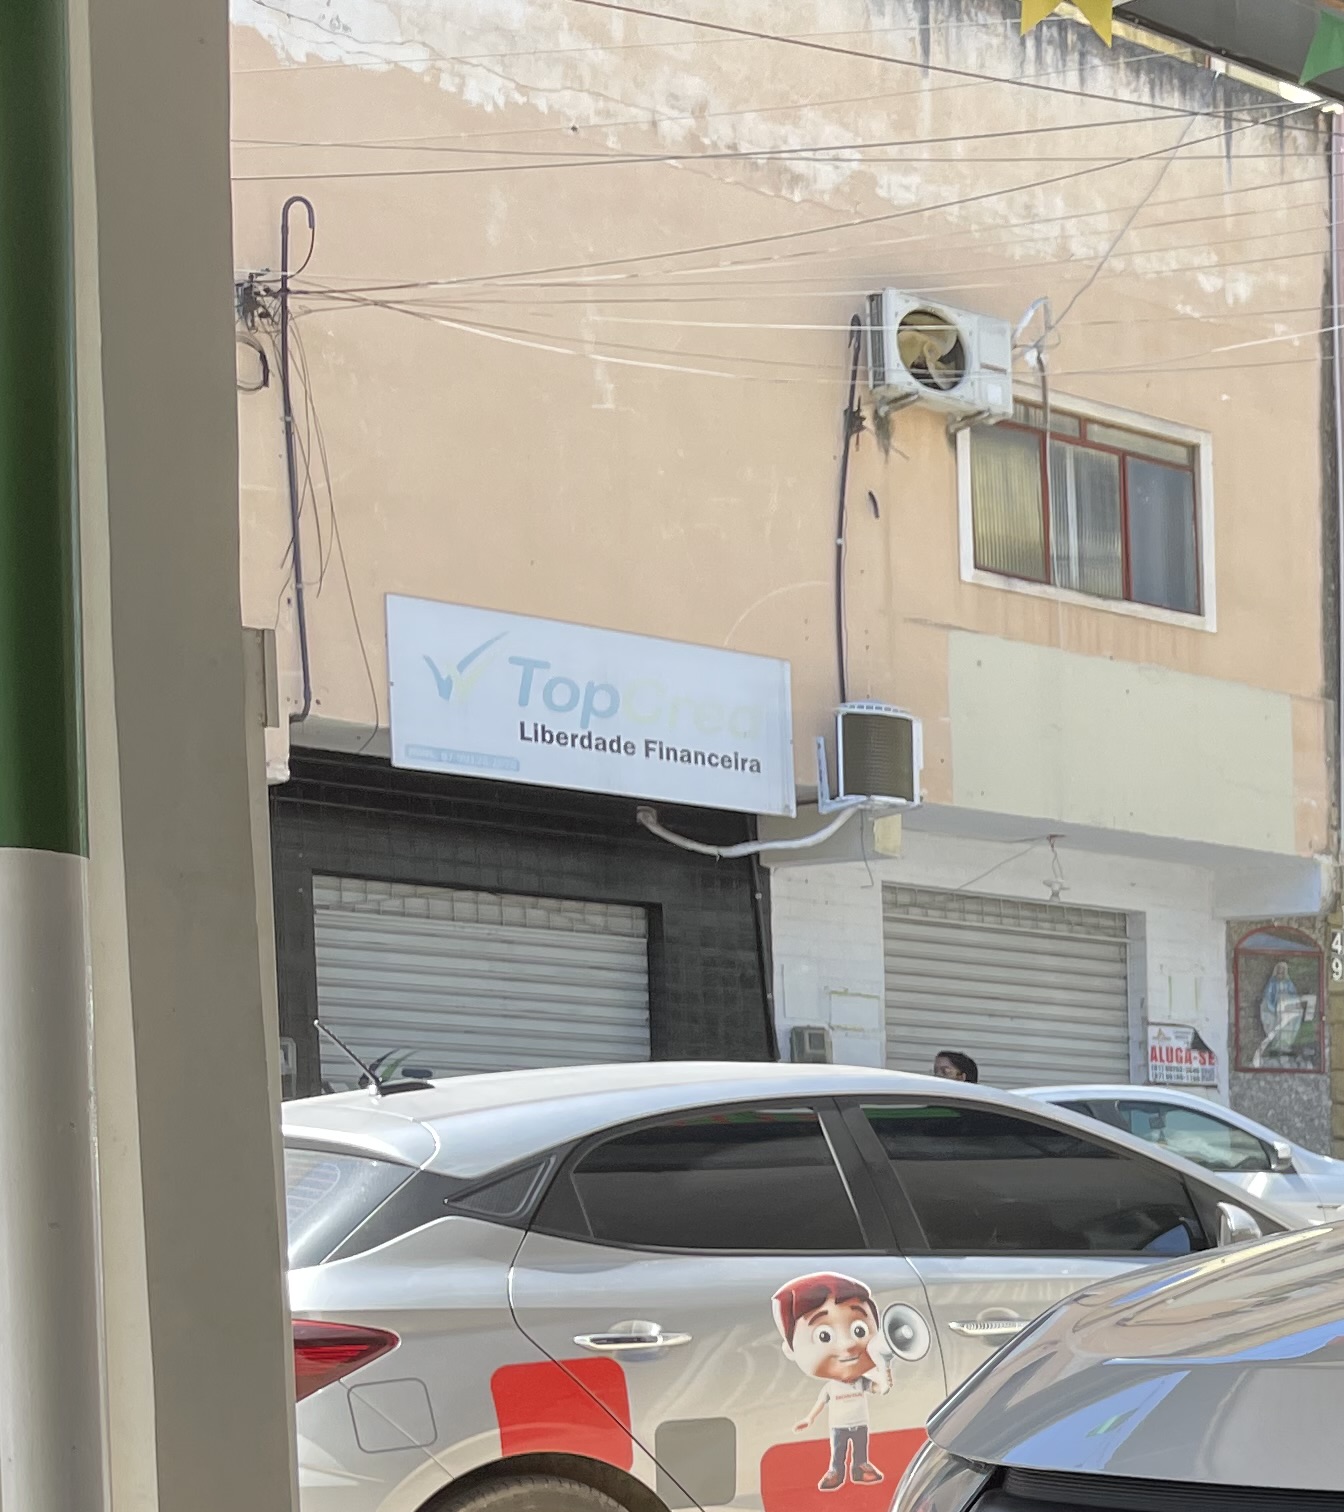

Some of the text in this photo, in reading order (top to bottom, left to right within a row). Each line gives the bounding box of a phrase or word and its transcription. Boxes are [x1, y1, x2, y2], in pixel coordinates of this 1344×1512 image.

[519, 721, 762, 774] Liberdade Financeira
[1150, 1045, 1216, 1066] ALUGA-SE
